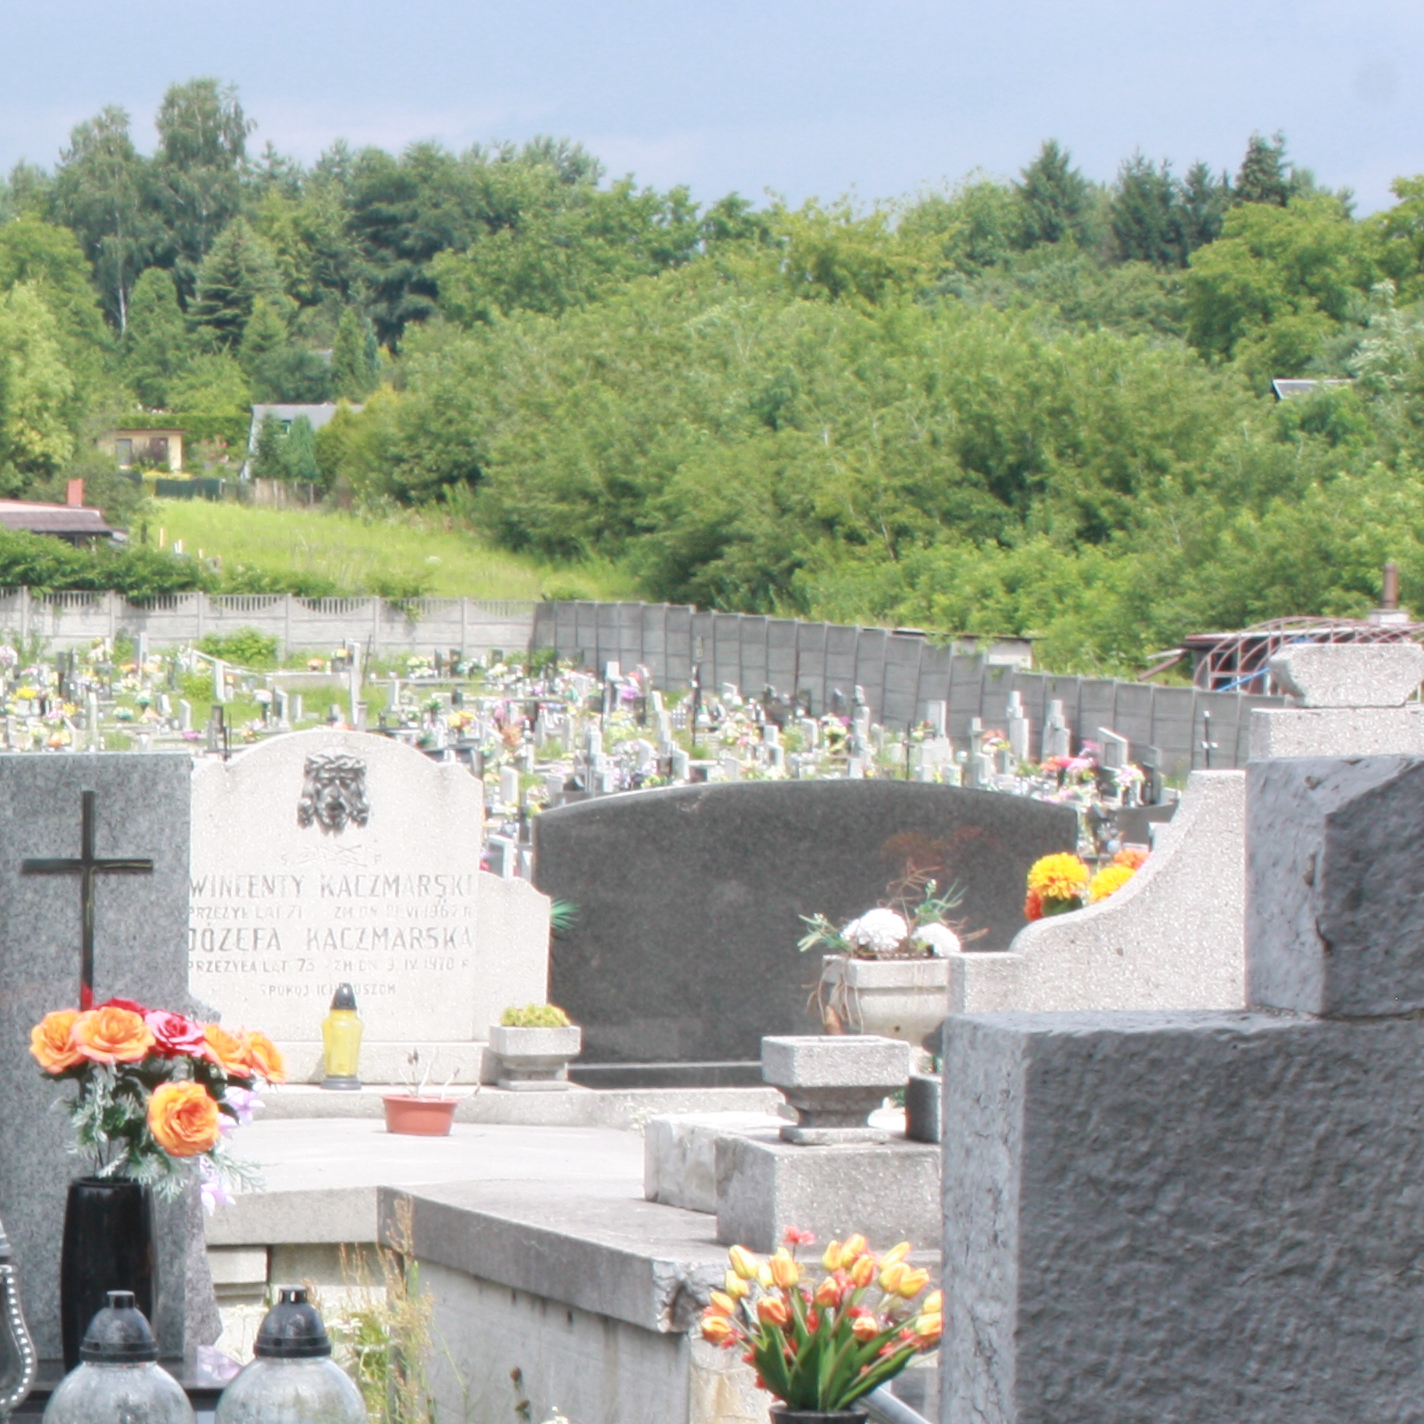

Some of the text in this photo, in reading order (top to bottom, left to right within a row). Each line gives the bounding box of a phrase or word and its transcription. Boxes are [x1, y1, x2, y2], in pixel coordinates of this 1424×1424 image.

[190, 872, 473, 900] WINCENTY KACZMARSKI
[188, 921, 474, 954] JÓZEFA KACZMARSKA
[262, 959, 287, 974] LAT
[354, 980, 398, 996] USZOM
